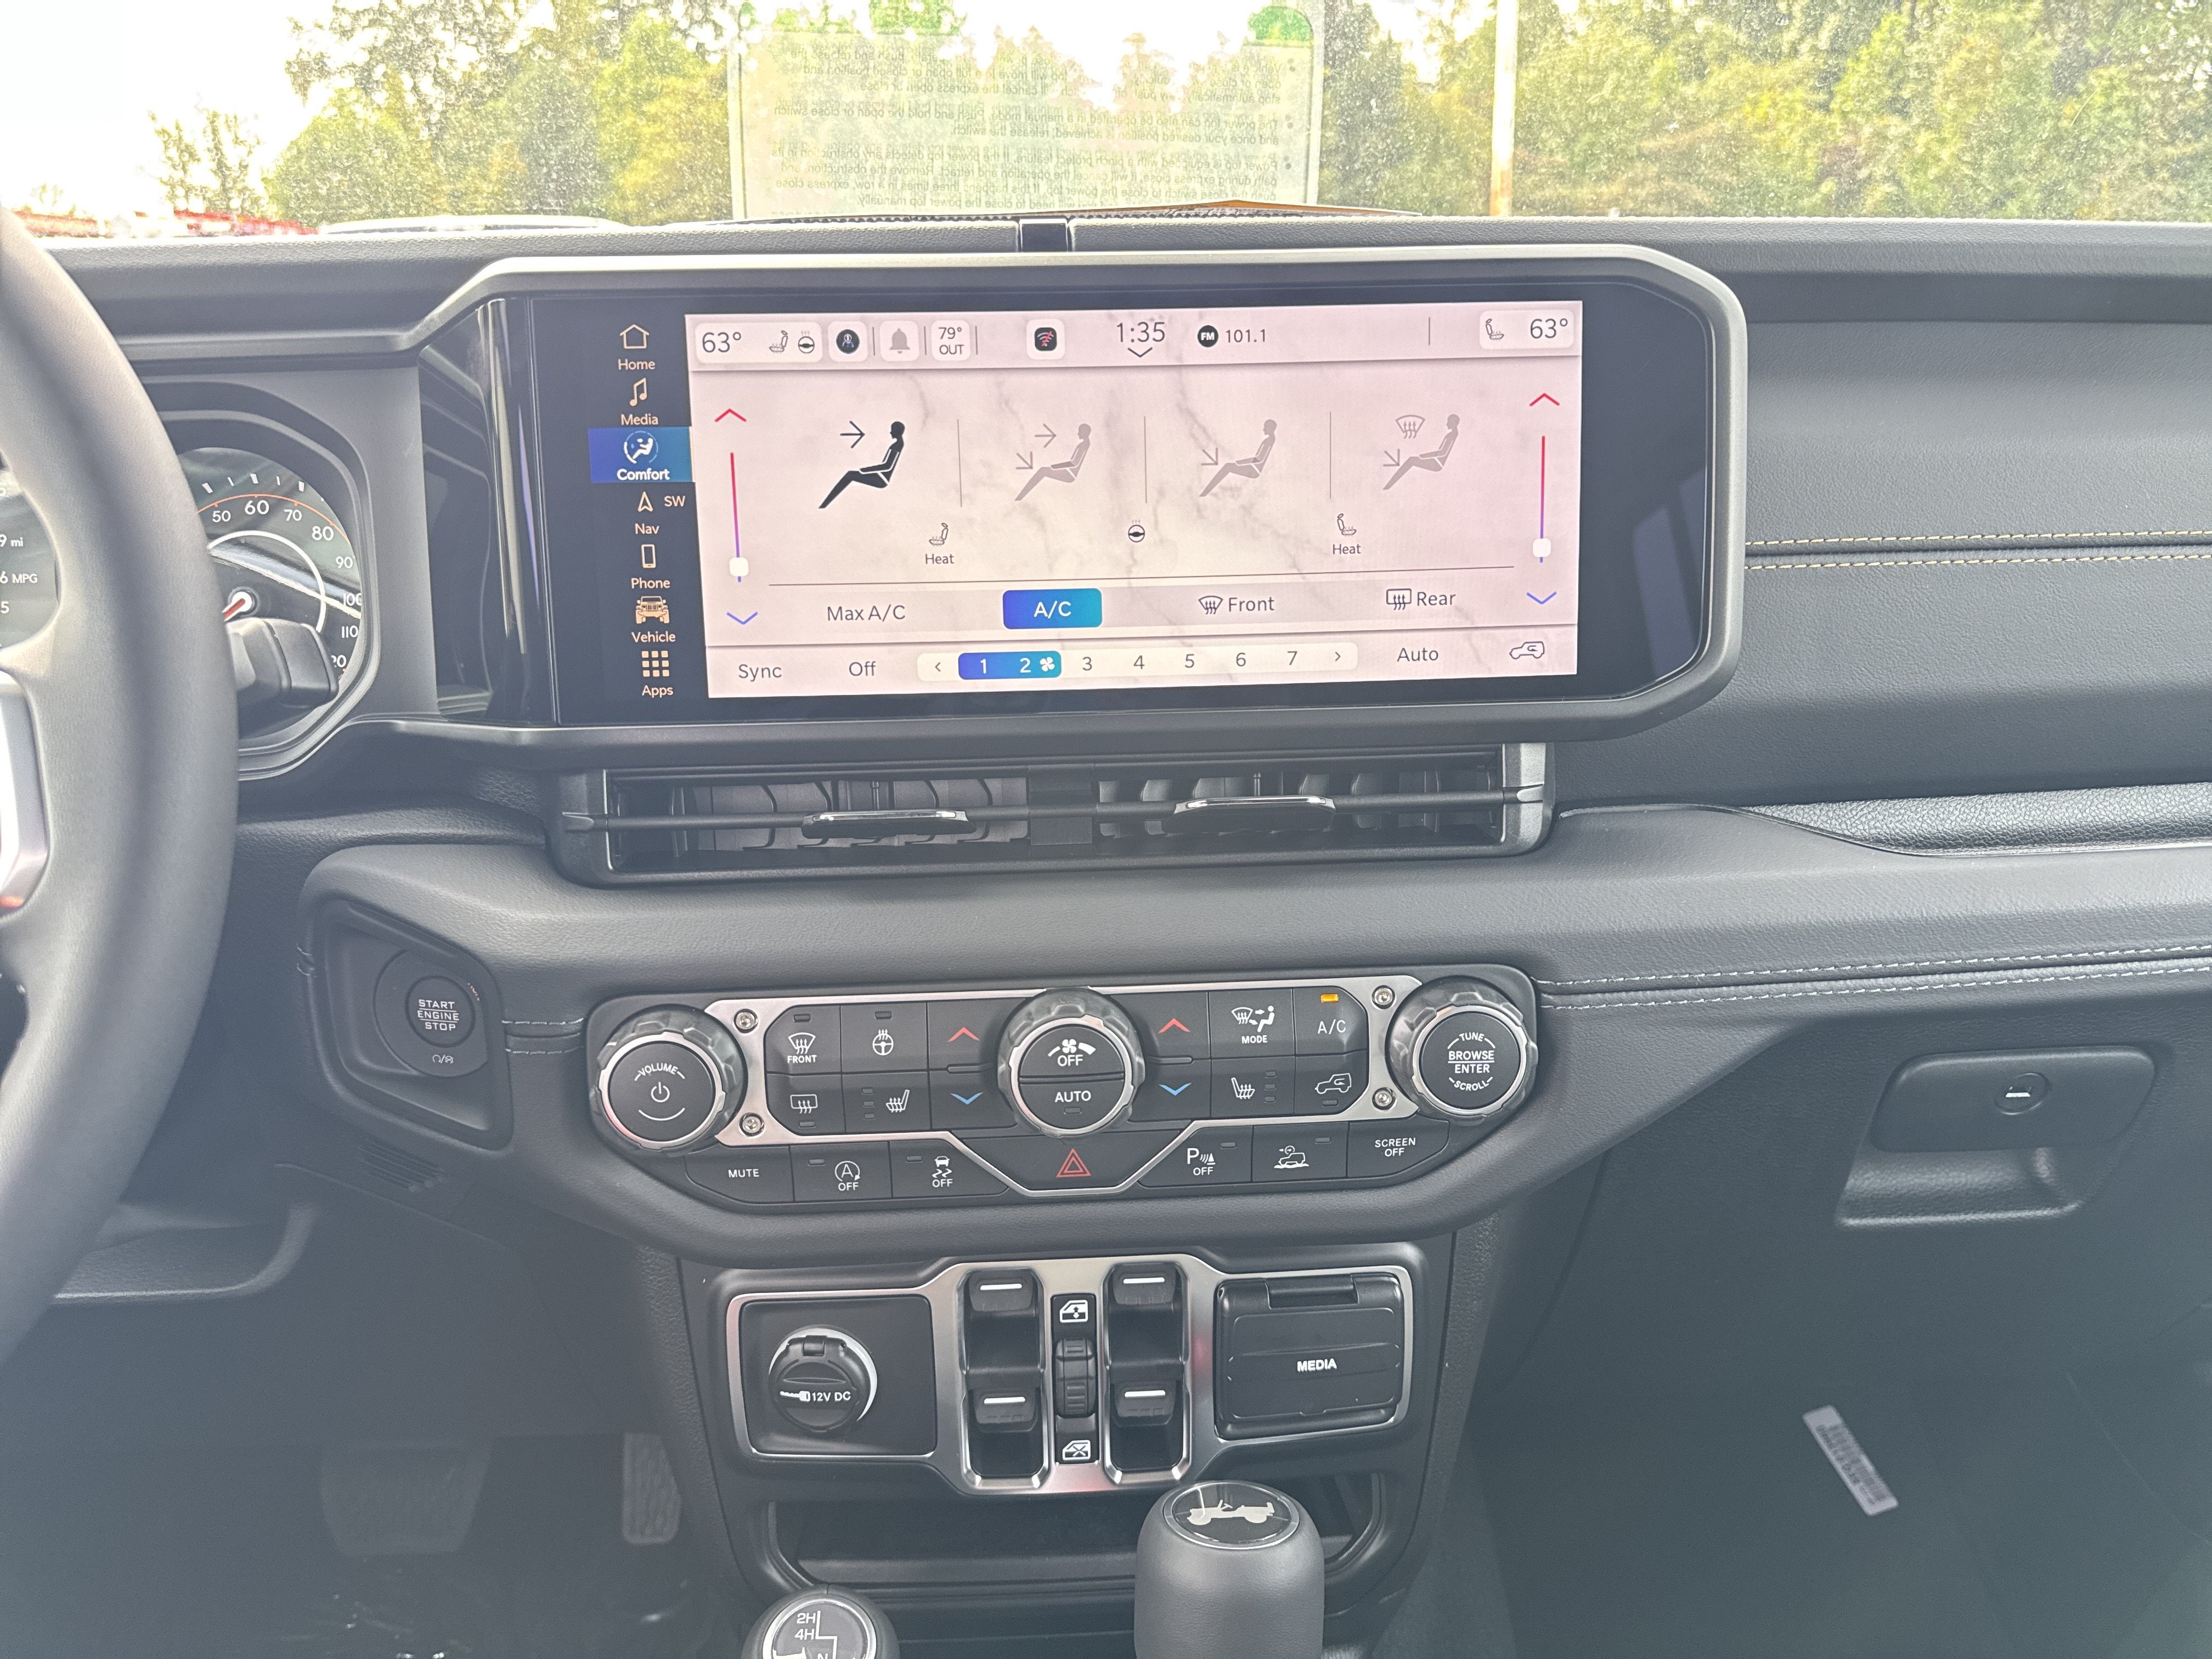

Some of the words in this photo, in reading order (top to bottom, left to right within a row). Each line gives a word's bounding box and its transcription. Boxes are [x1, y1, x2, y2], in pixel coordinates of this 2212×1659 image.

[938, 326, 962, 340] 79°
[1116, 321, 1166, 343] 1:35
[1530, 318, 1568, 339] 63°
[702, 331, 742, 353] 63°
[1200, 332, 1215, 341] FM
[1226, 329, 1266, 343] 101.1
[939, 344, 964, 355] OUT
[618, 359, 656, 370] Home
[620, 414, 658, 426] Media
[617, 468, 670, 481] Comfort
[664, 495, 685, 507] SW
[244, 500, 269, 515] 60
[212, 510, 232, 522] 50
[284, 509, 302, 522] 70
[312, 526, 334, 541] 80
[635, 523, 659, 534] Nav
[11, 537, 24, 547] mi
[1333, 544, 1361, 555] Heat
[335, 556, 353, 569] 90
[925, 554, 955, 565] Heat
[12, 574, 38, 583] MPG
[631, 578, 670, 589] Phone
[343, 592, 362, 606] 100
[1228, 596, 1275, 612] Front
[1417, 590, 1456, 606] Rear
[827, 606, 865, 622] Max
[868, 605, 906, 622] A/C
[1034, 601, 1071, 618] A/C
[342, 625, 358, 638] 110
[631, 631, 676, 642] Vehicle
[1397, 646, 1438, 662] Auto
[979, 659, 987, 674] 1
[1019, 658, 1031, 673] 2
[1082, 657, 1093, 672] 3
[1133, 654, 1146, 670] 4
[1185, 653, 1195, 668] 5
[1236, 652, 1246, 667] 6
[1287, 650, 1298, 665] 7
[738, 663, 782, 682] Sync
[849, 661, 876, 677] Off
[641, 685, 674, 698] Apps
[419, 999, 455, 1009] START
[417, 1010, 459, 1020] ENGINE
[425, 1022, 456, 1031] STOP
[1318, 1019, 1346, 1035] A/C
[1242, 1035, 1267, 1044] MODE
[1459, 1032, 1485, 1041] TUNE
[787, 1054, 817, 1064] FRONT
[1057, 1054, 1083, 1066] OFF
[1448, 1050, 1494, 1060] BROWSE
[638, 1063, 678, 1076] VOLUME
[1454, 1064, 1490, 1074] ENTER
[1454, 1080, 1485, 1091] SCROLL
[1055, 1091, 1091, 1102] AUTO
[1375, 1137, 1416, 1148] SCREEN
[1187, 1148, 1199, 1164] P
[1384, 1147, 1404, 1157] OFF
[728, 1169, 759, 1178] MUTE
[1193, 1167, 1213, 1176] OFF
[838, 1182, 859, 1192] OFF
[932, 1178, 953, 1188] OFF
[1296, 1358, 1337, 1373] MEDIA
[812, 1392, 831, 1401] 12V
[834, 1391, 851, 1401] DC
[797, 1613, 816, 1624] 2H
[795, 1628, 814, 1640] 4H
